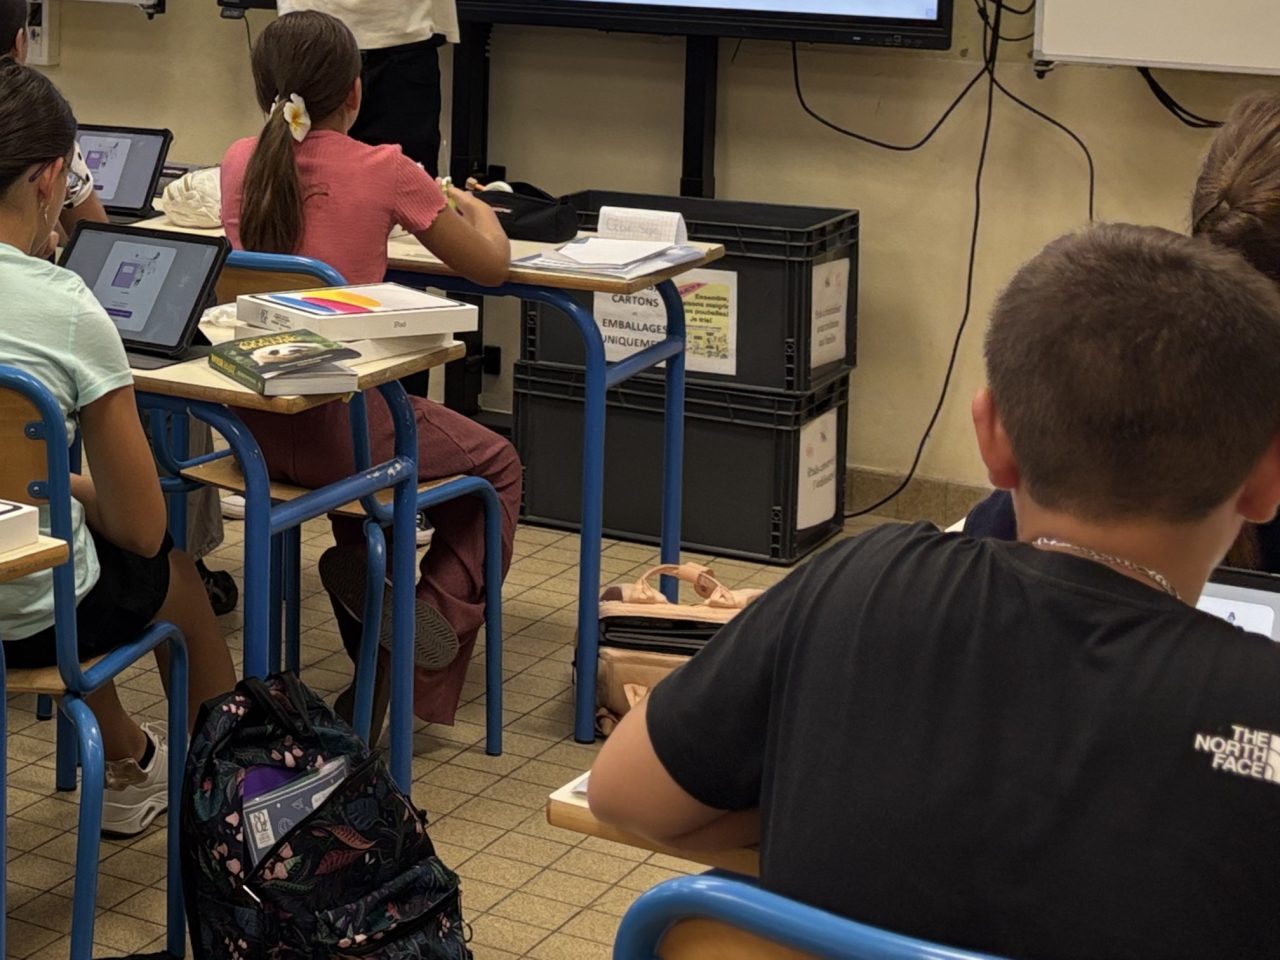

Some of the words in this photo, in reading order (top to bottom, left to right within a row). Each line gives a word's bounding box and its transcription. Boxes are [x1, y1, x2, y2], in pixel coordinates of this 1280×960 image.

[611, 294, 660, 308] CARTONS
[1194, 733, 1269, 762] NORTH
[1231, 725, 1270, 748] THE
[1211, 752, 1264, 779] FACE
